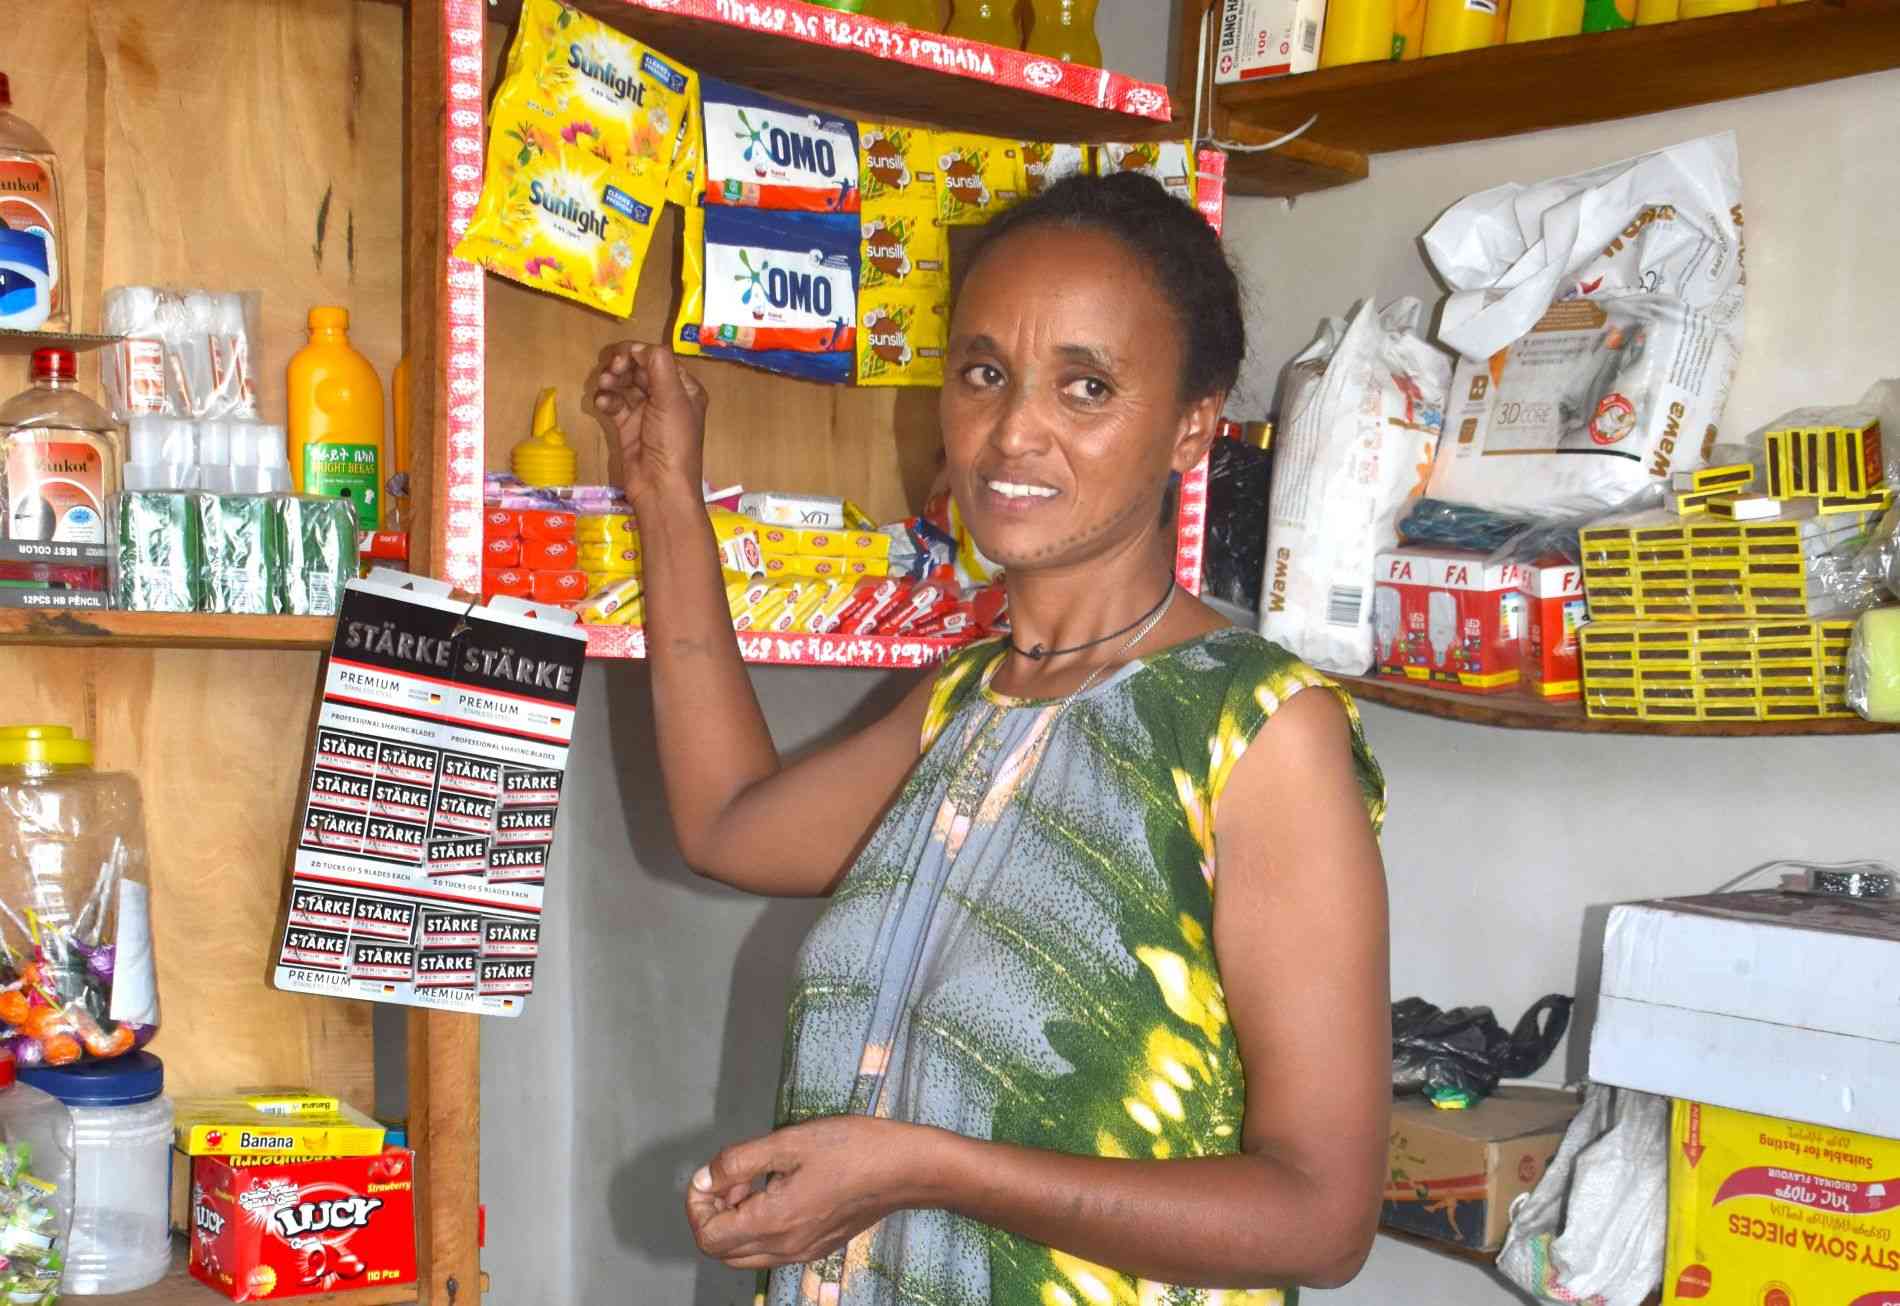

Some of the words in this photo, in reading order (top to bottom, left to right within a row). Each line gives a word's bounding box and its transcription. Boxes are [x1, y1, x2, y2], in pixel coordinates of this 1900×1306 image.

[1223, 12, 1237, 47] BANG
[1257, 30, 1268, 57] 100
[567, 43, 647, 107] Sunlight
[770, 128, 836, 178] OMO
[867, 154, 906, 170] sunsilk
[946, 174, 982, 189] sunsilk
[528, 180, 609, 240] Sunlight
[867, 243, 906, 259] sunsilk
[768, 268, 832, 317] OMO
[868, 331, 906, 347] sunsilk
[1649, 401, 1685, 478] Wawa
[801, 510, 829, 525] LUX
[51, 545, 78, 556] BEST
[1268, 547, 1291, 613] Wawa
[1390, 560, 1412, 580] FA
[1445, 565, 1468, 585] FA
[345, 620, 452, 668] STÄRKE
[464, 647, 574, 692] STÄRKE
[340, 671, 400, 692] PREMIUM
[459, 695, 519, 715] PREMIUM
[331, 712, 380, 728] PROFESSIONAL
[381, 722, 409, 733] SHAVING
[322, 738, 375, 759] STÄRKE
[451, 735, 499, 751] PROFESSIONAL
[382, 749, 433, 770] STÄRKE
[446, 760, 497, 782] STÄRKE
[317, 776, 369, 797] STÄRKE
[507, 773, 557, 790] STÄRKE
[376, 786, 428, 807] STÄRKE
[441, 797, 492, 818] STÄRKE
[310, 814, 363, 835] STÄRKE
[501, 812, 551, 828] STÄRKE
[370, 824, 422, 844] STÄRKE
[431, 843, 482, 860] STÄRKE
[492, 850, 542, 866] STÄRKE
[322, 861, 346, 871] TUCKS
[392, 871, 411, 881] EACH
[297, 895, 350, 915] STÄRKE
[358, 903, 410, 924] STÄRKE
[427, 916, 478, 932] STÄRKE
[489, 925, 536, 941] STÄRKE
[289, 932, 344, 953] STÄRKE
[359, 948, 412, 965] STÄRKE
[420, 955, 472, 971] STÄRKE
[288, 969, 351, 986] PREMIUM
[484, 963, 532, 978] STÄRKE
[414, 986, 474, 1001] PREMIUM
[240, 1133, 294, 1148] Banana
[1759, 1133, 1800, 1151] fasting
[1802, 1145, 1821, 1158] for
[1823, 1149, 1873, 1169] Suitable
[1768, 1167, 1811, 1184] FLAVOUR
[1815, 1171, 1858, 1192] ORIGINAL
[367, 1181, 411, 1194] Strawberry
[275, 1194, 383, 1237] LUCY
[1729, 1213, 1797, 1247] PIECES
[1802, 1230, 1858, 1261] SOYA
[367, 1271, 380, 1281] 110
[382, 1270, 401, 1280] Pcs
